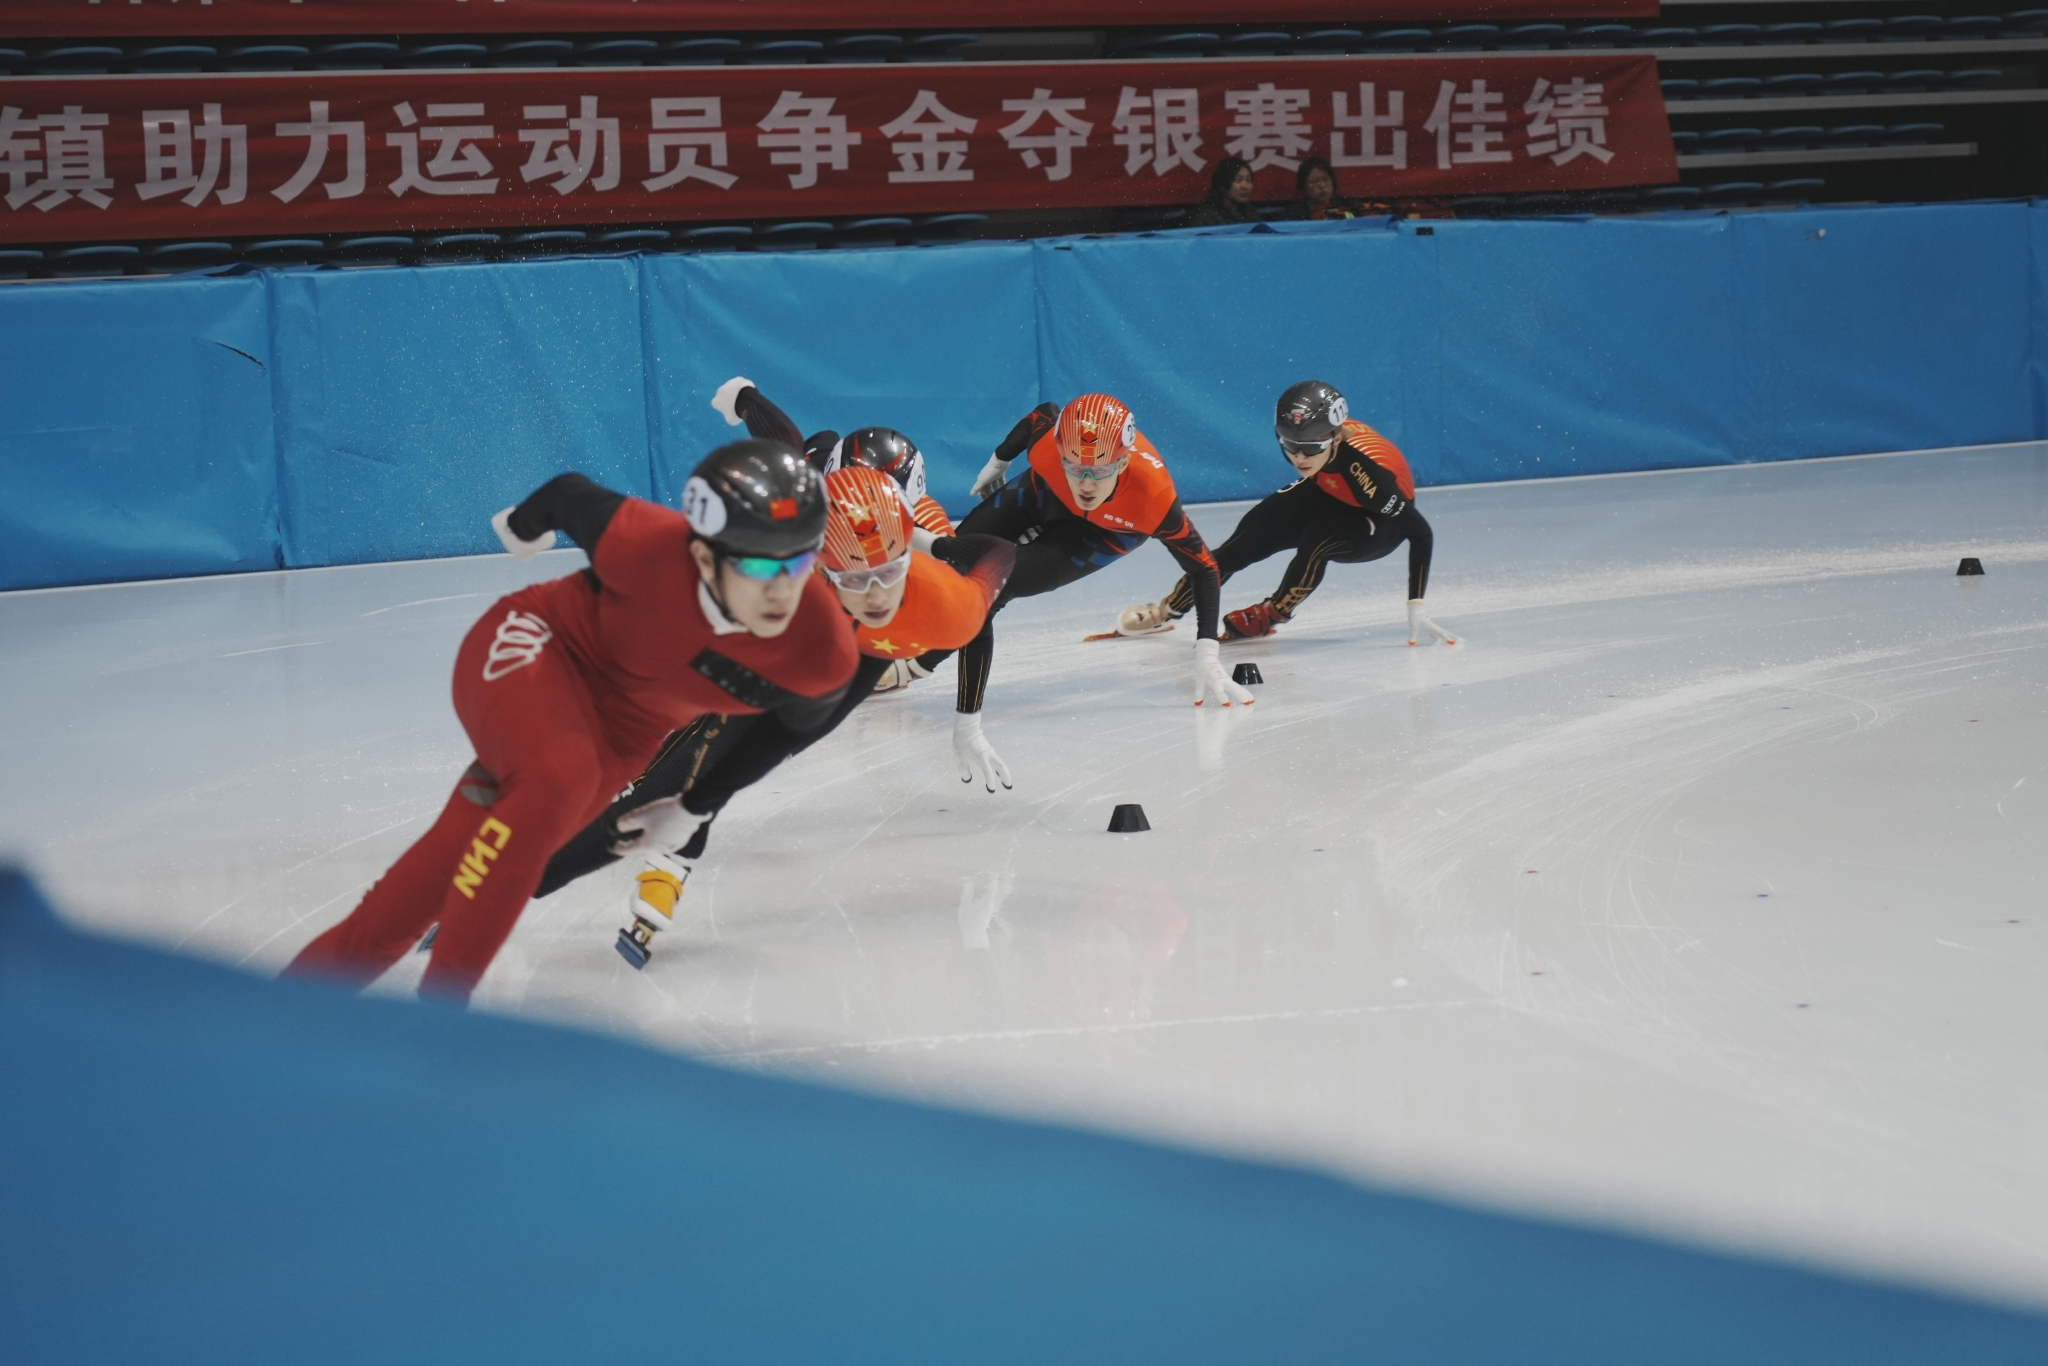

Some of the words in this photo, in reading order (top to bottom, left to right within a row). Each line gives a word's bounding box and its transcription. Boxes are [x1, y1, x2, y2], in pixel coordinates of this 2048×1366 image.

[0, 76, 1615, 213] 镇助力运动员争金夺银赛出佳绩
[1350, 462, 1377, 499] CHINA
[453, 817, 512, 900] CHN
